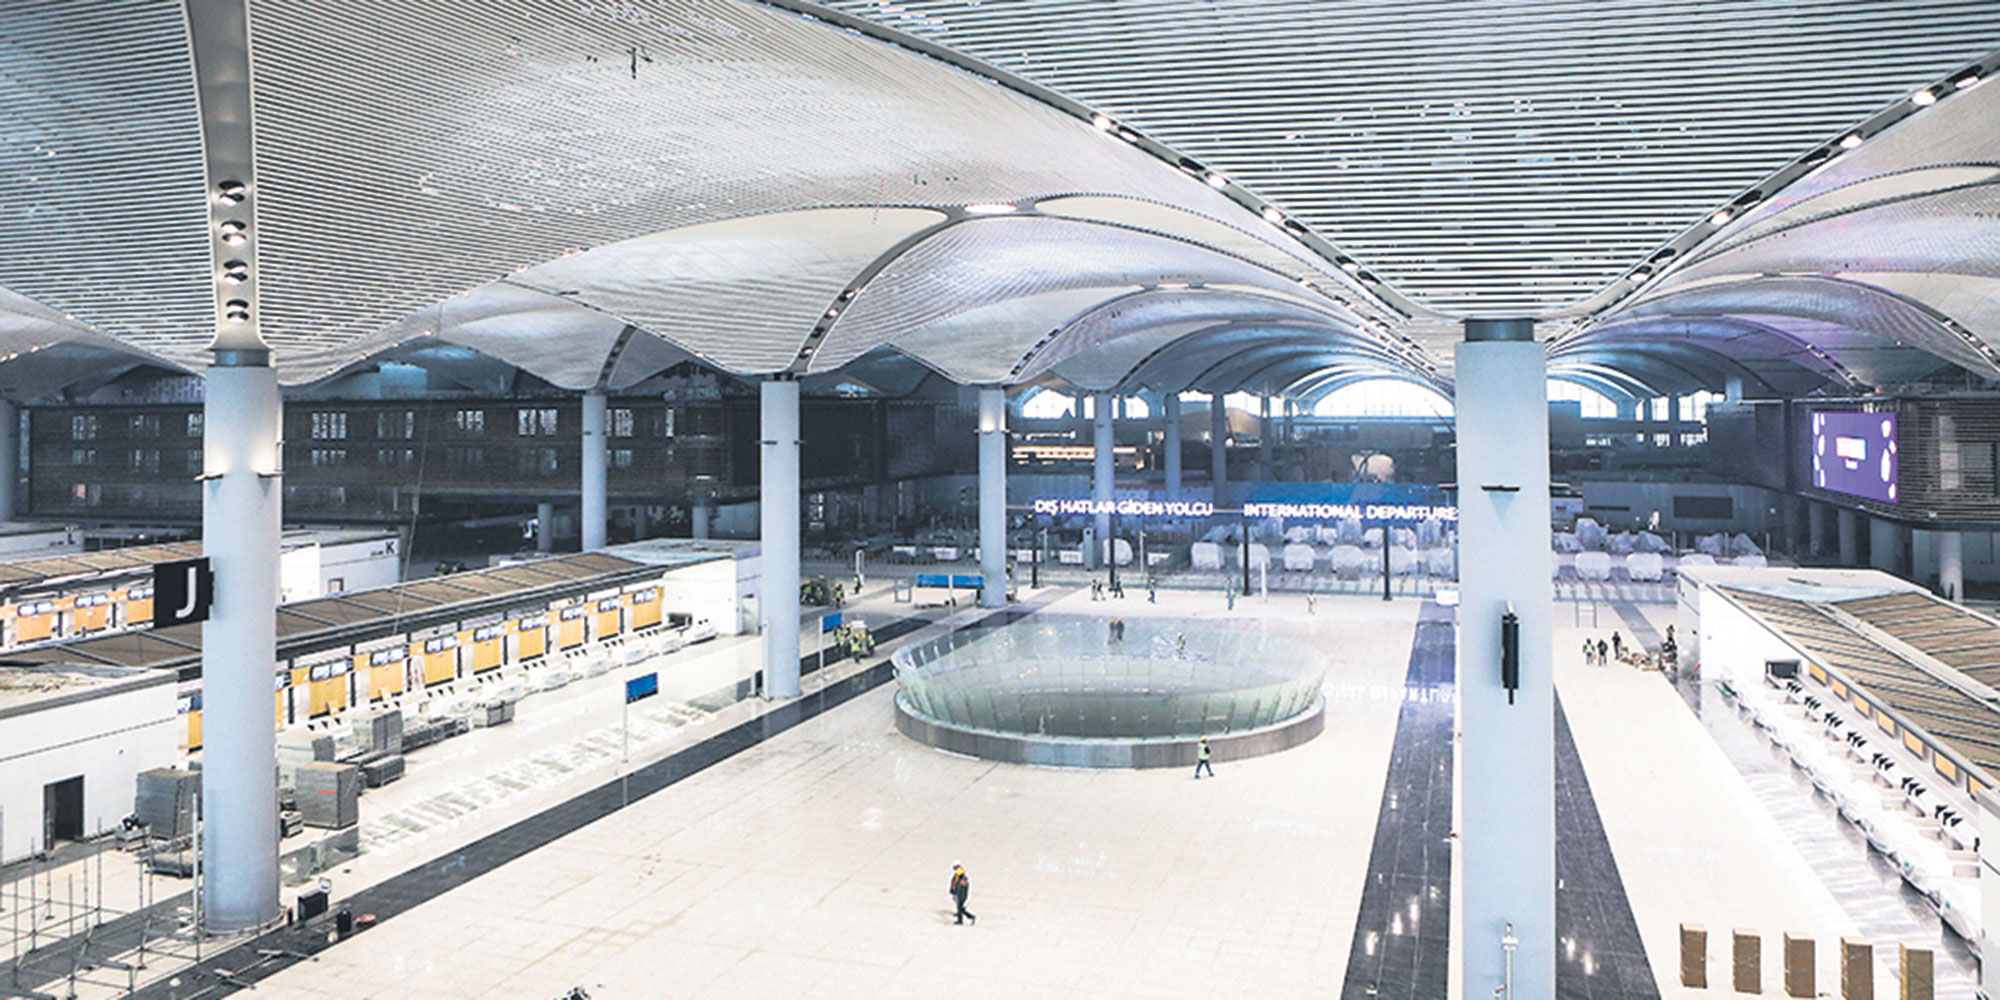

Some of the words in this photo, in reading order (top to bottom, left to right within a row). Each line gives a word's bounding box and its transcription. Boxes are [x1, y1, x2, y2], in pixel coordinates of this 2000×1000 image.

[1034, 499, 1058, 516] DIŞ
[1060, 500, 1115, 515] HATLAR
[1117, 498, 1164, 516] GİDEN
[1164, 501, 1214, 517] YOLCU
[1243, 502, 1363, 519] INTERNATIONAL
[385, 541, 395, 554] K
[175, 566, 197, 618] J
